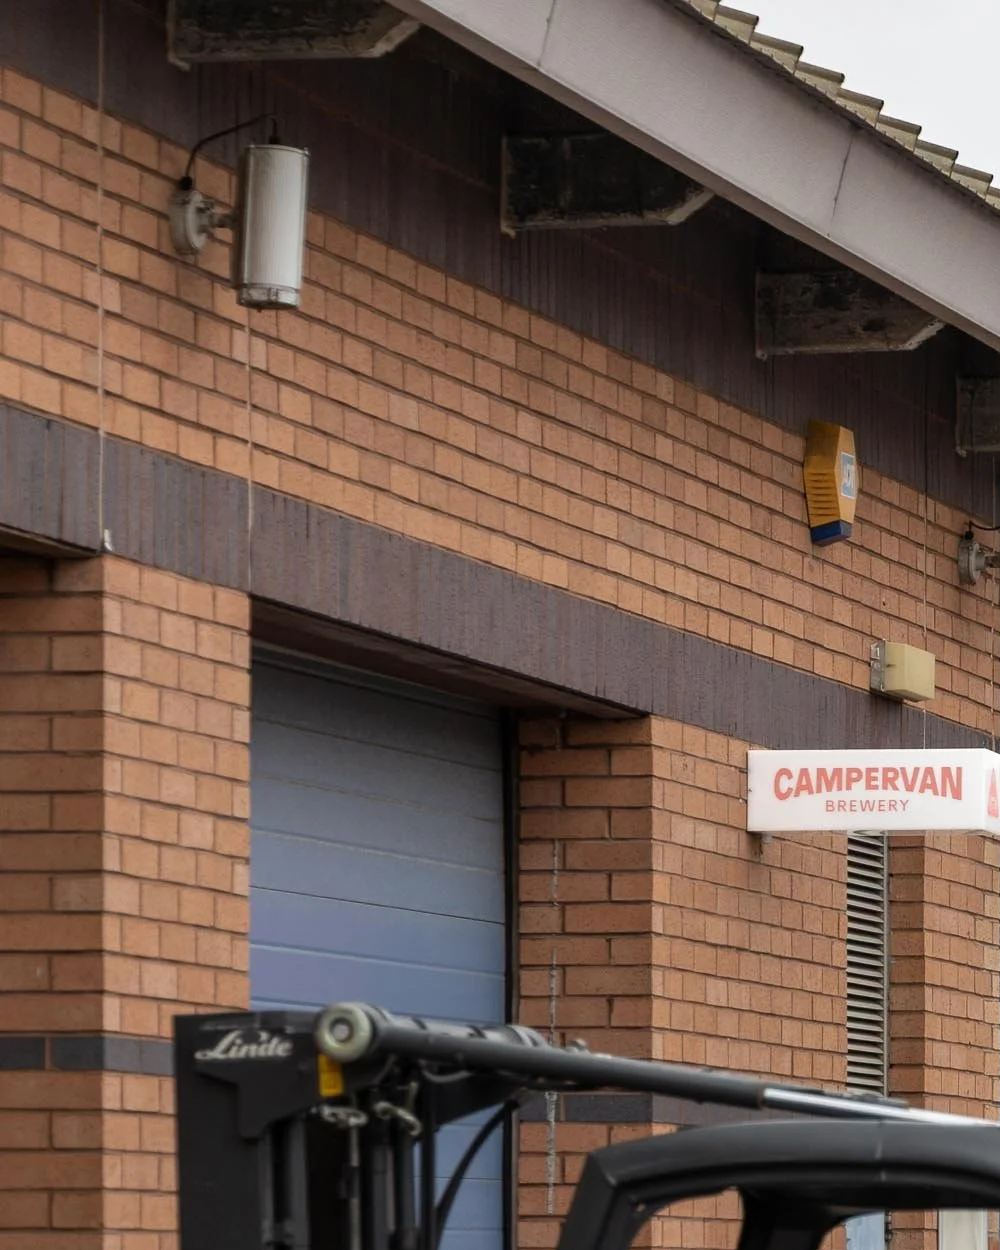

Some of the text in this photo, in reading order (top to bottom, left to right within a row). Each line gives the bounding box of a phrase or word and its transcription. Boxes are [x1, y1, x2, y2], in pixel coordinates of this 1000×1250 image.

[773, 766, 963, 801] CAMPERVAN
[825, 799, 910, 813] BREWERY
[194, 1029, 293, 1060] Linde
